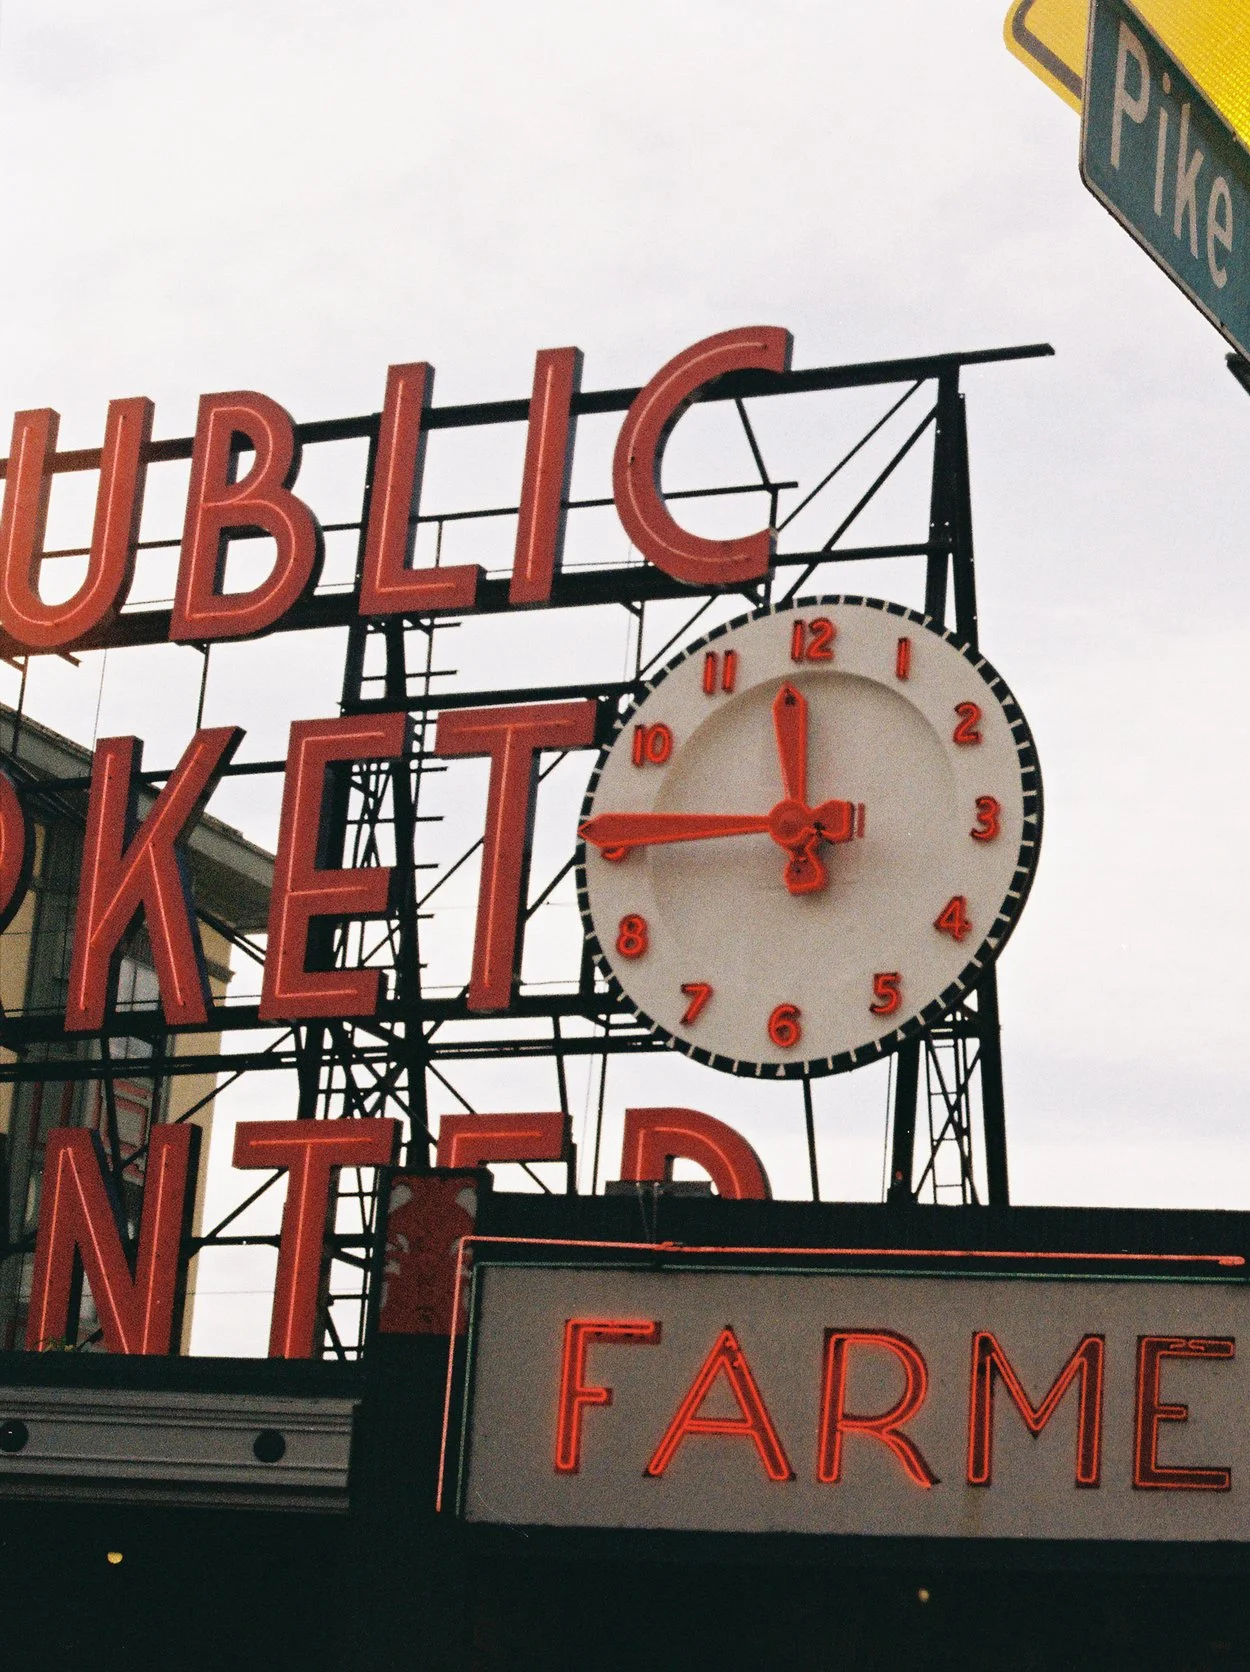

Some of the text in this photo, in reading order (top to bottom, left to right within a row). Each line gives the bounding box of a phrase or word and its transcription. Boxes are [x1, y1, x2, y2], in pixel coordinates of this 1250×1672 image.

[1109, 20, 1234, 290] Pike
[0, 325, 796, 647] UBLIC
[790, 617, 838, 663] 12
[895, 636, 912, 682] 1
[703, 649, 738, 695] 11
[631, 723, 674, 768] 10
[953, 702, 983, 745] 2
[970, 796, 1001, 842] 3
[0, 700, 598, 1032] KET
[616, 914, 650, 959] 8
[933, 896, 973, 943] 4
[680, 982, 714, 1026] 7
[869, 972, 903, 1016] 5
[767, 1003, 802, 1048] 6
